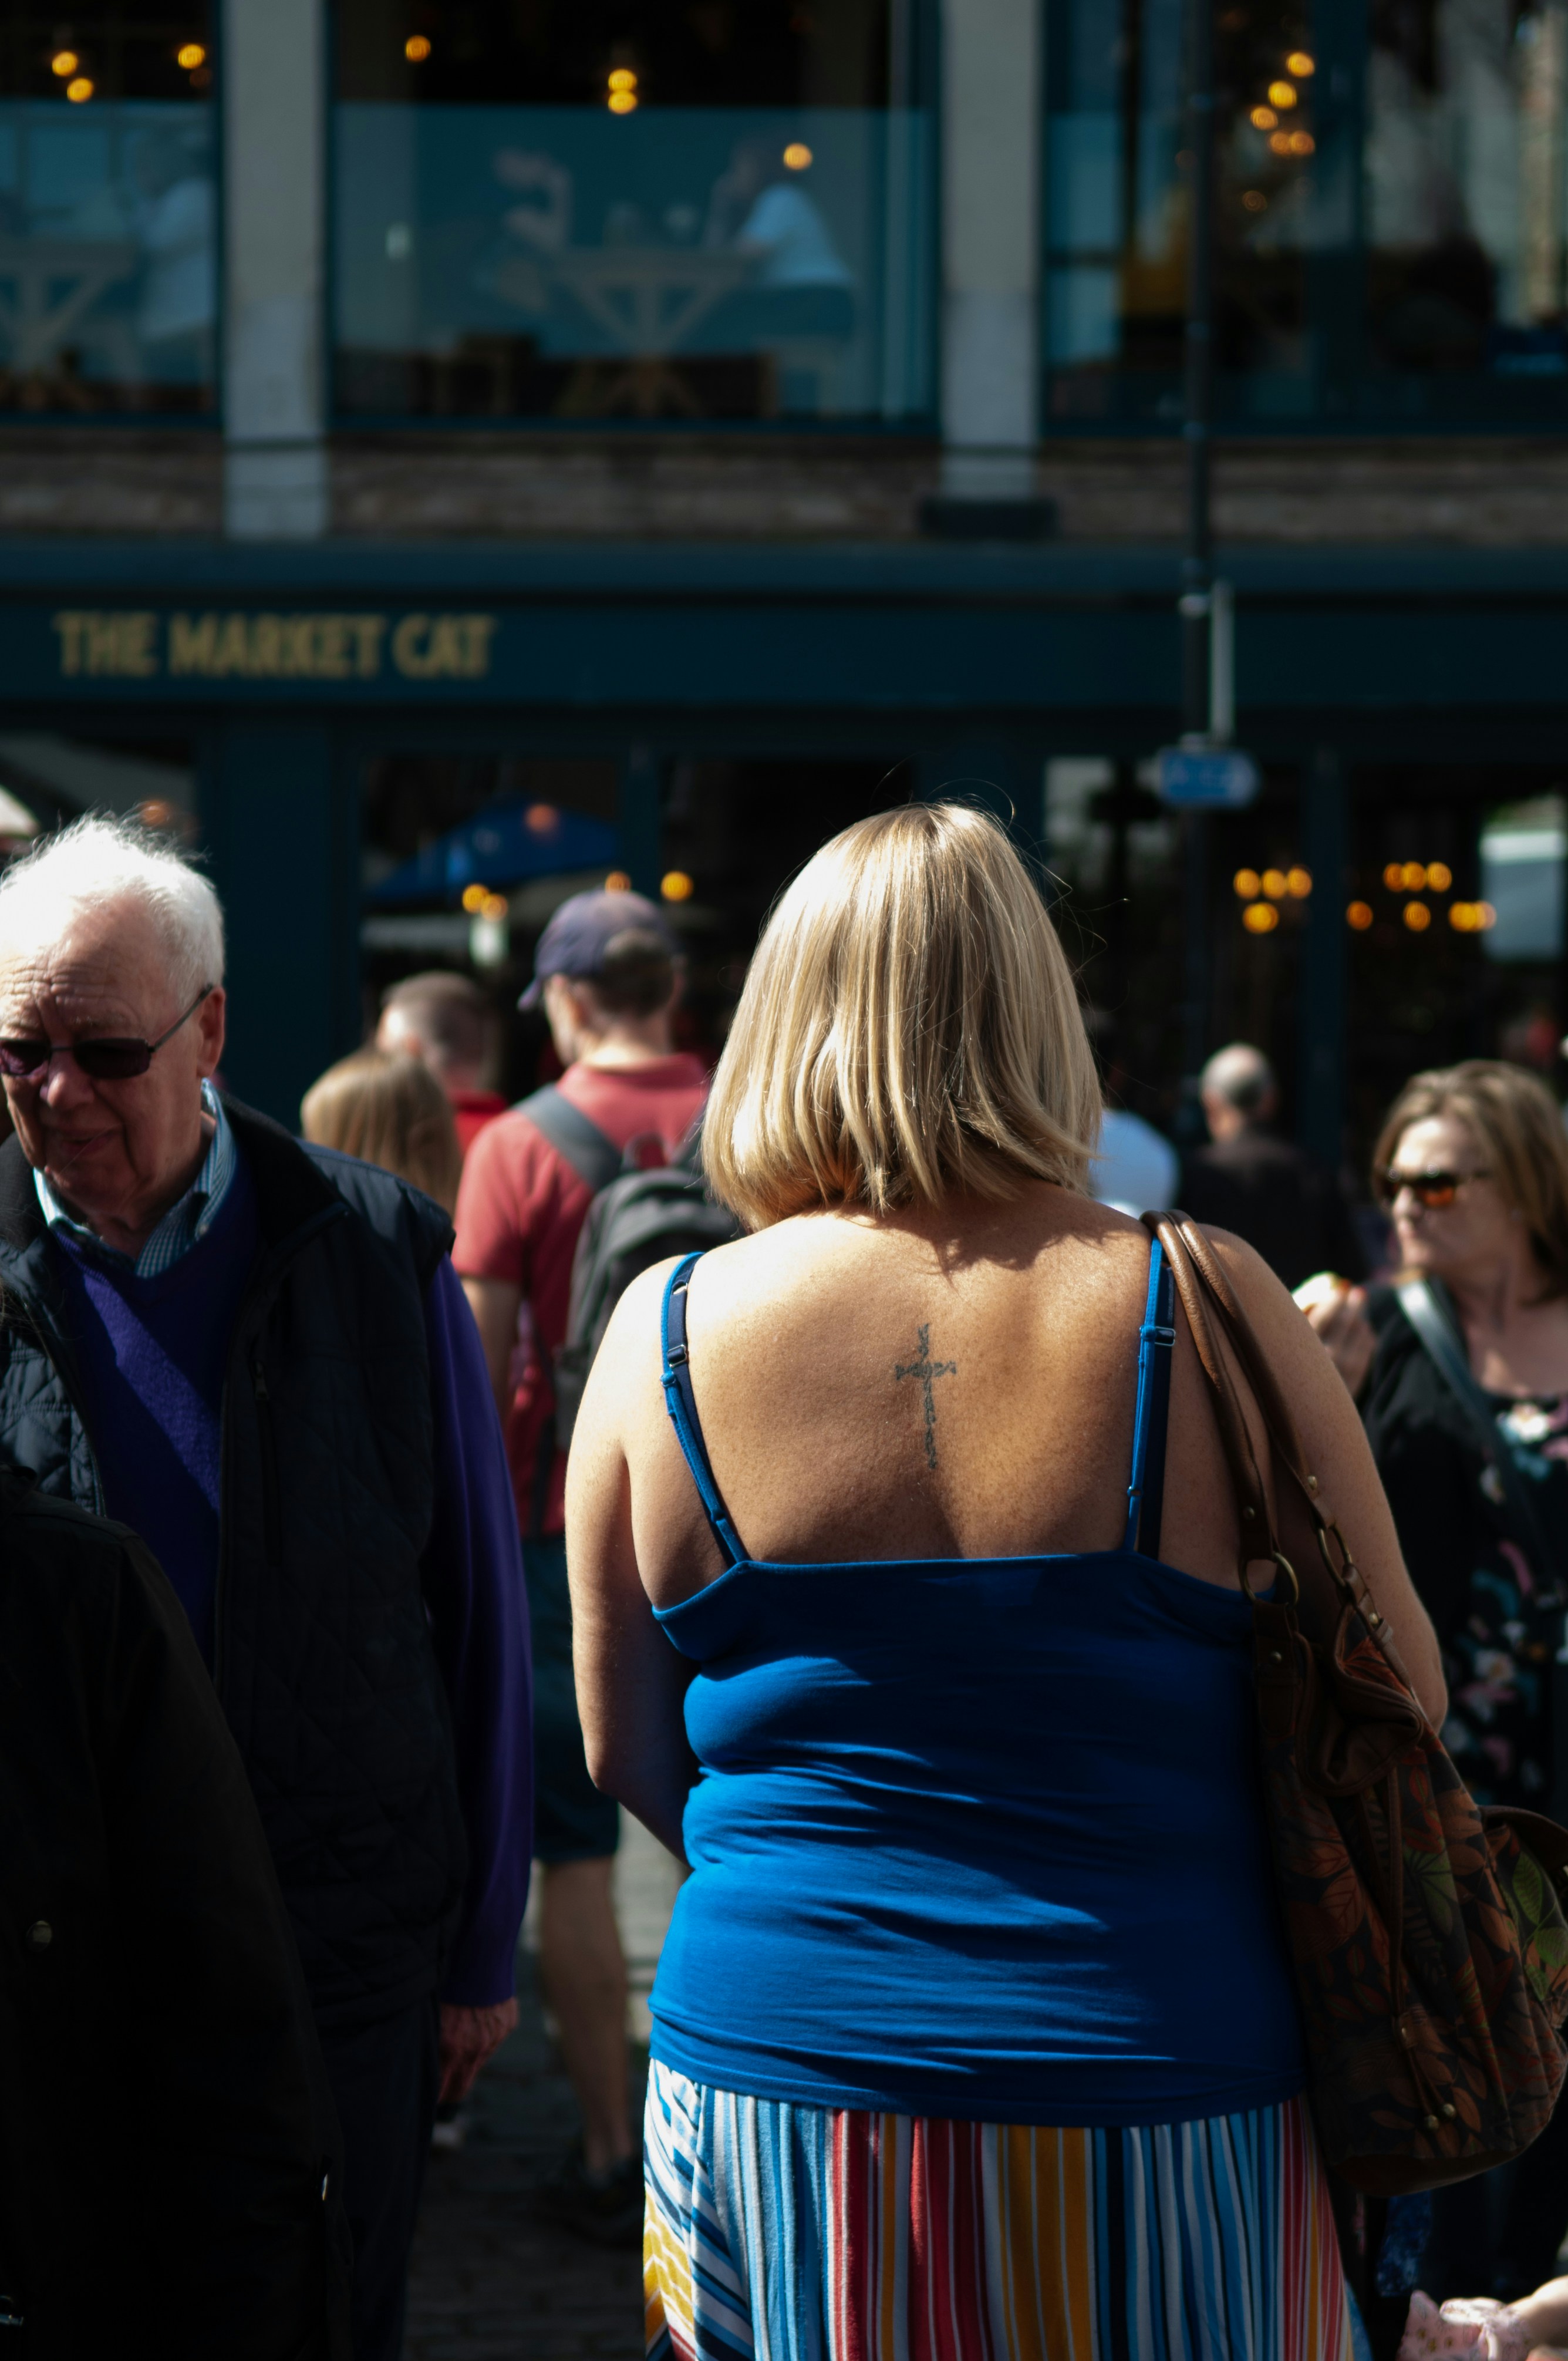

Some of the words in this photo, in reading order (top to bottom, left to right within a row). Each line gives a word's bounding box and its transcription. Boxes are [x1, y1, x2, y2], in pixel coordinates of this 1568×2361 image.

[54, 612, 157, 678] THE
[168, 612, 386, 678] MARKET
[391, 612, 495, 678] CAT
